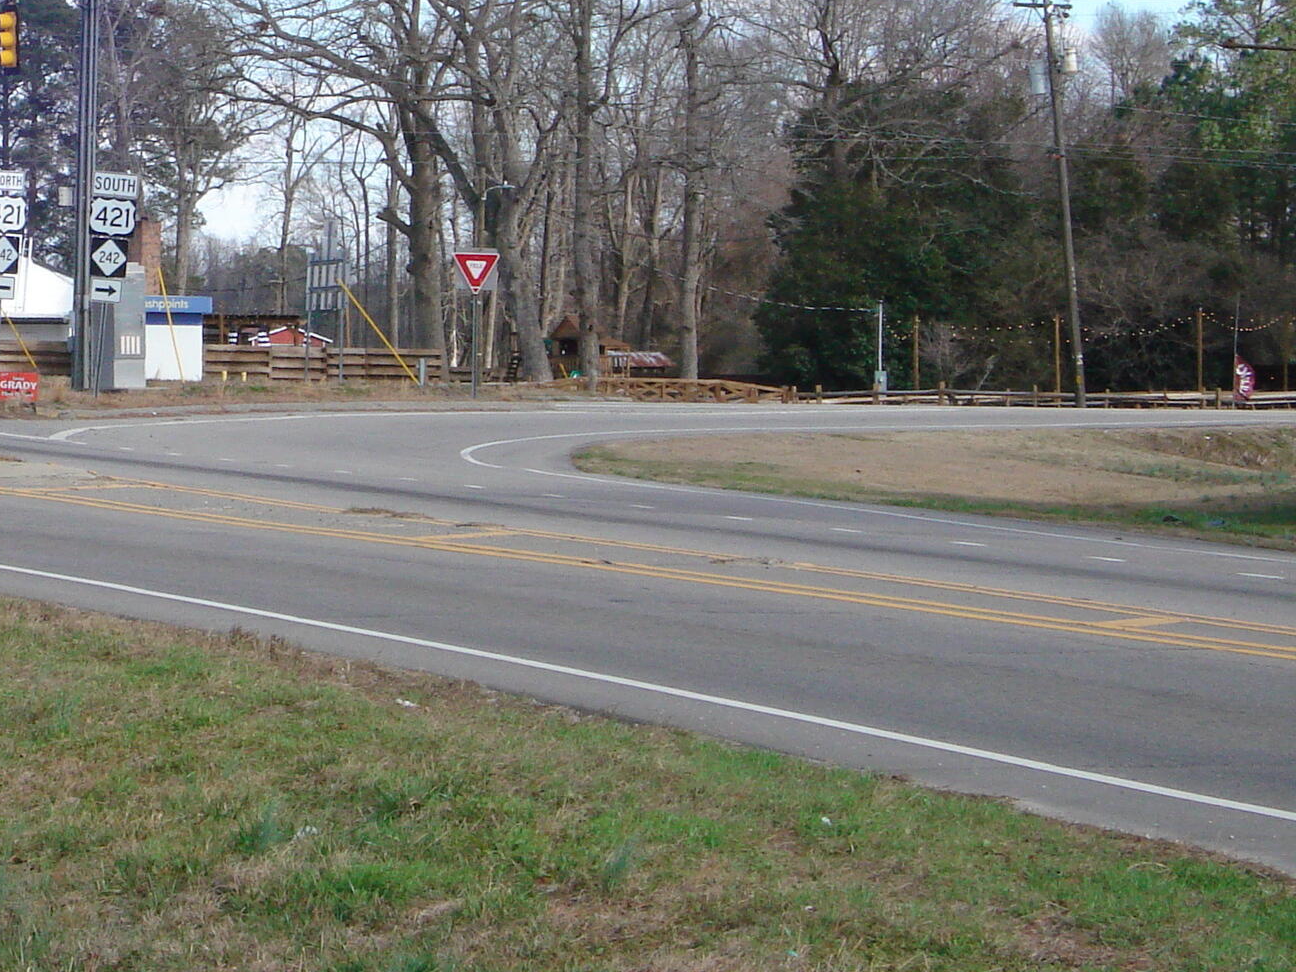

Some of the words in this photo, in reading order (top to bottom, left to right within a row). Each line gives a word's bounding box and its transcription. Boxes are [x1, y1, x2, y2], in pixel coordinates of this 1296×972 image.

[95, 176, 136, 193] SOUTH
[95, 206, 130, 228] 421
[99, 251, 120, 265] 242
[145, 298, 189, 311] ashpoints
[0, 380, 38, 390] GRADY
